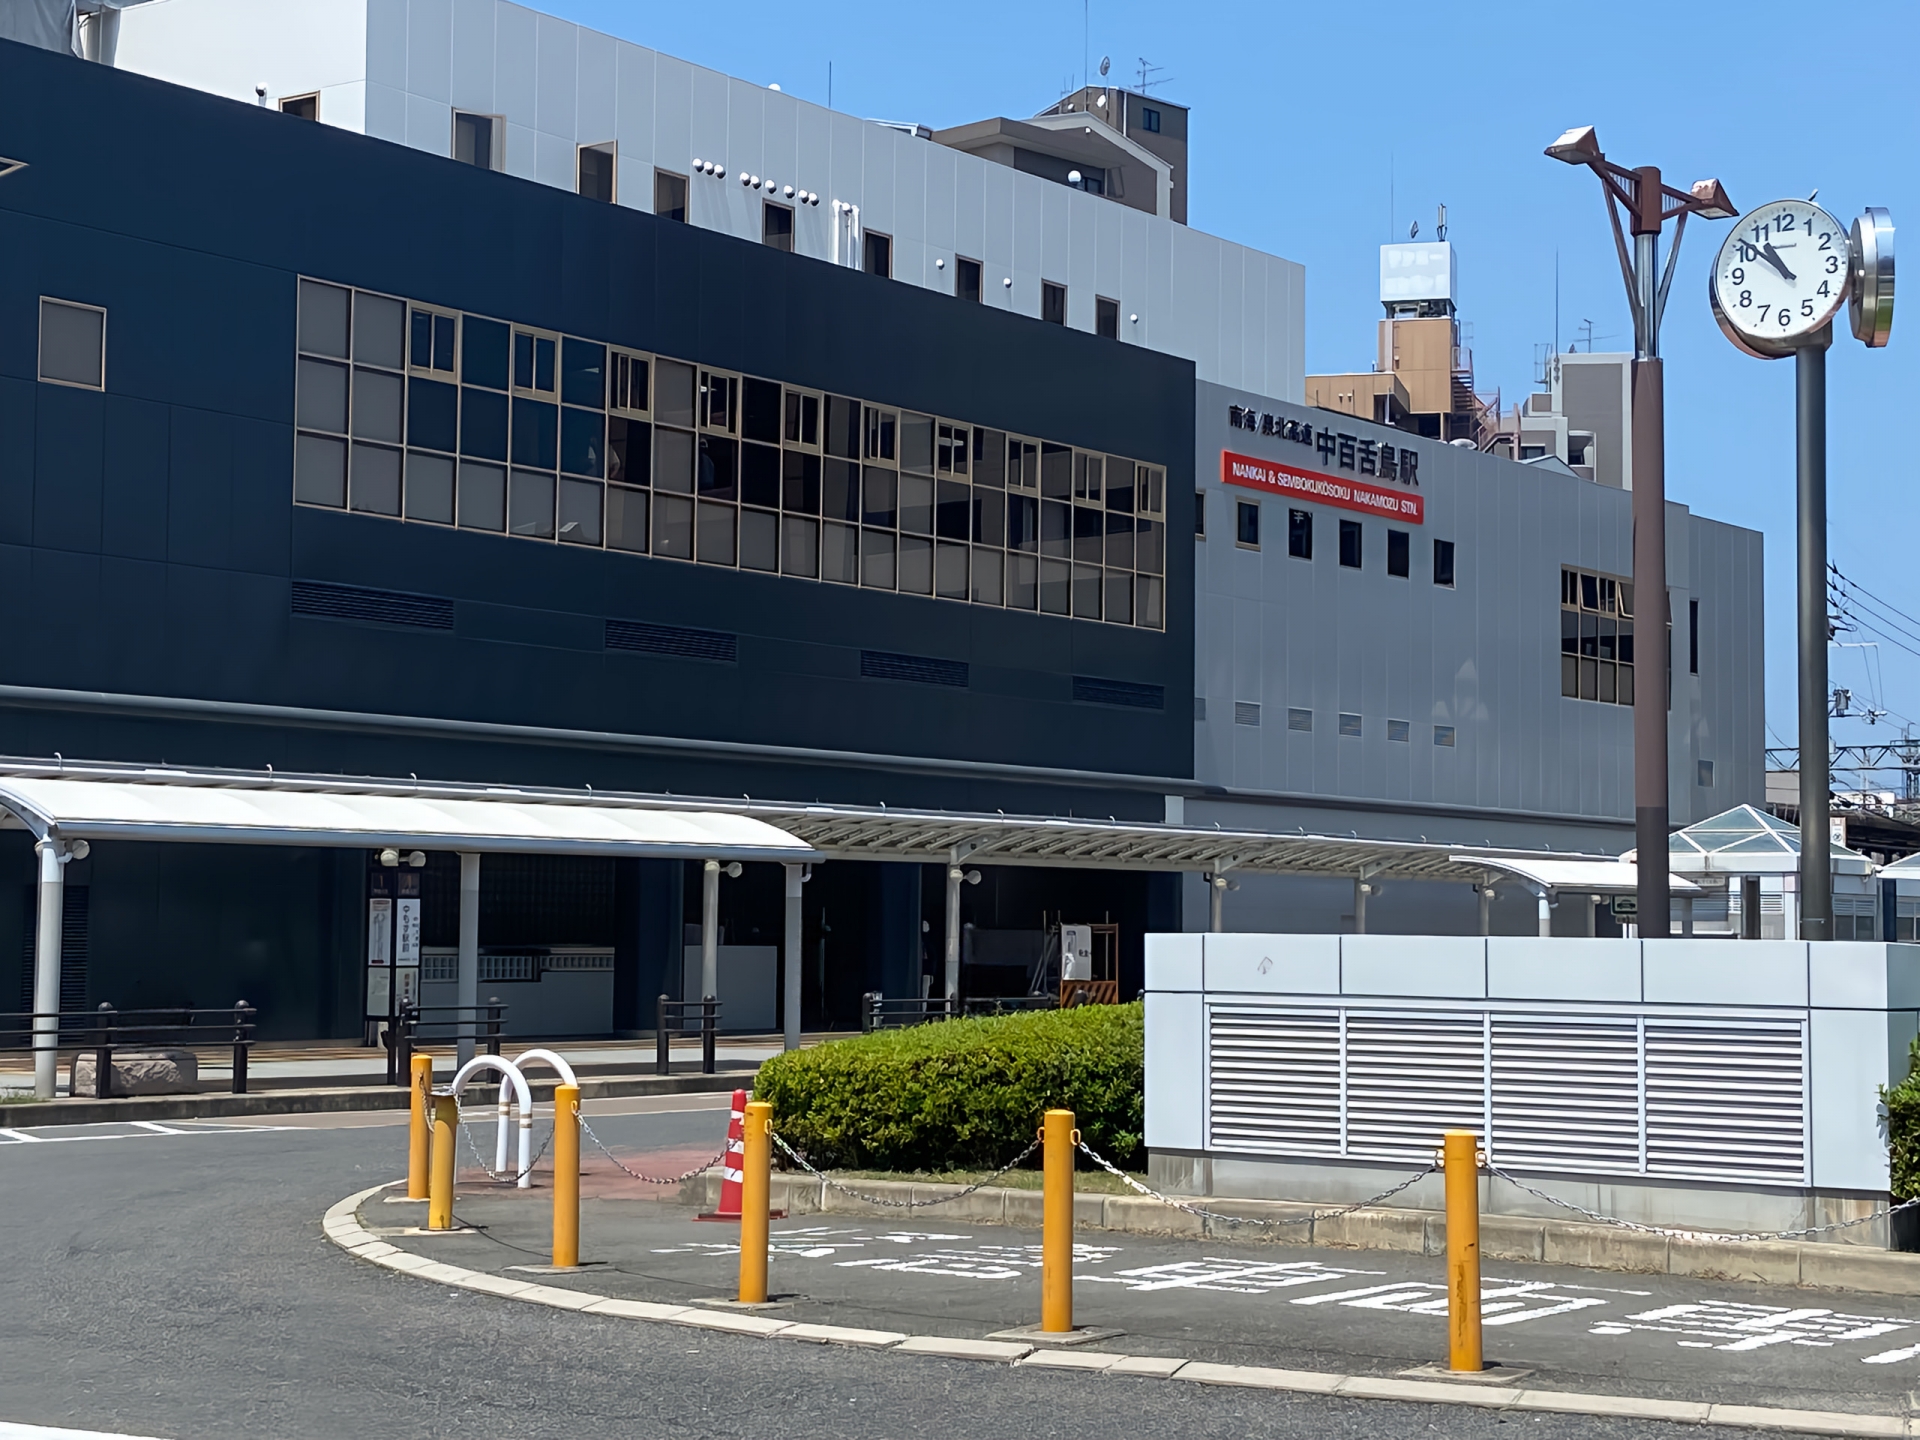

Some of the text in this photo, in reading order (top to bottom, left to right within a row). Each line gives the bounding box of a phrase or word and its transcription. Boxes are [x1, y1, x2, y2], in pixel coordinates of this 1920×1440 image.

[1773, 213, 1795, 232] 12
[1803, 218, 1812, 236] 1
[1751, 223, 1769, 242] 11
[1818, 232, 1831, 250] 2
[1735, 244, 1757, 263] 10
[1825, 256, 1838, 274] 3
[1731, 268, 1744, 285] 9
[1816, 280, 1830, 298] 4
[1739, 290, 1752, 308] 8
[1800, 299, 1813, 317] 5
[1757, 304, 1771, 322] 7
[1778, 309, 1791, 326] 6
[1316, 427, 1419, 486] 中百舌鳥駅
[1232, 462, 1266, 482] NANKAI
[1268, 470, 1276, 484] &
[1353, 489, 1399, 511] NAKAMOZU
[650, 1227, 1920, 1363] 緊急車両専
